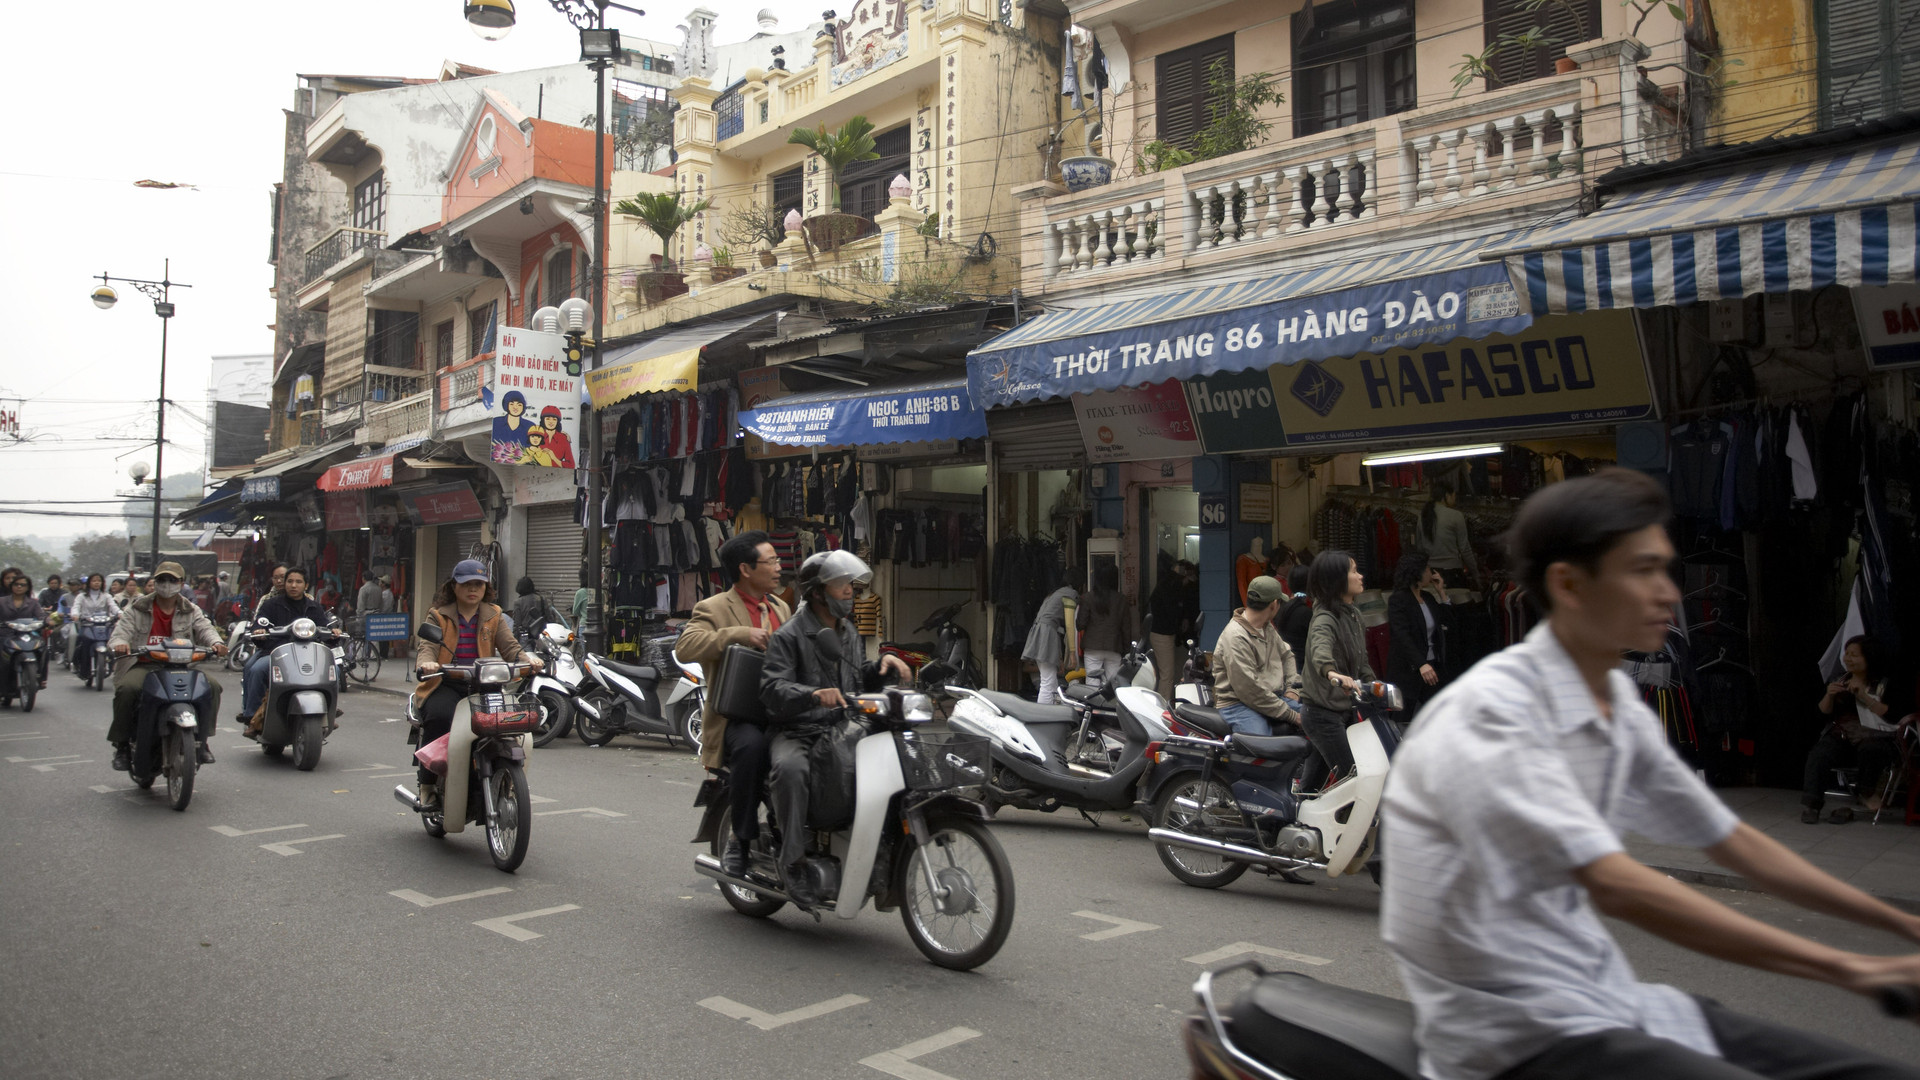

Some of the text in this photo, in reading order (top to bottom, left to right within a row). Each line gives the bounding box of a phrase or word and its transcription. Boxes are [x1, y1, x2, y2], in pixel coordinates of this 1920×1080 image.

[502, 333, 517, 348] HÃY
[1052, 289, 1460, 379] THỜI TRANG 86 HÀNG ĐÀO
[502, 353, 559, 372] ĐỘI MŨ BẢO HIỂM
[1359, 335, 1595, 409] HAFASCO
[500, 373, 512, 385] KHI
[513, 375, 520, 387] ĐI
[523, 375, 533, 389] MÔ
[548, 379, 557, 391] XE
[558, 378, 574, 392] MÁY
[1190, 381, 1271, 419] Hapro
[890, 414, 914, 427] TRANG
[802, 434, 826, 443] TRANG
[1202, 503, 1226, 524] 86
